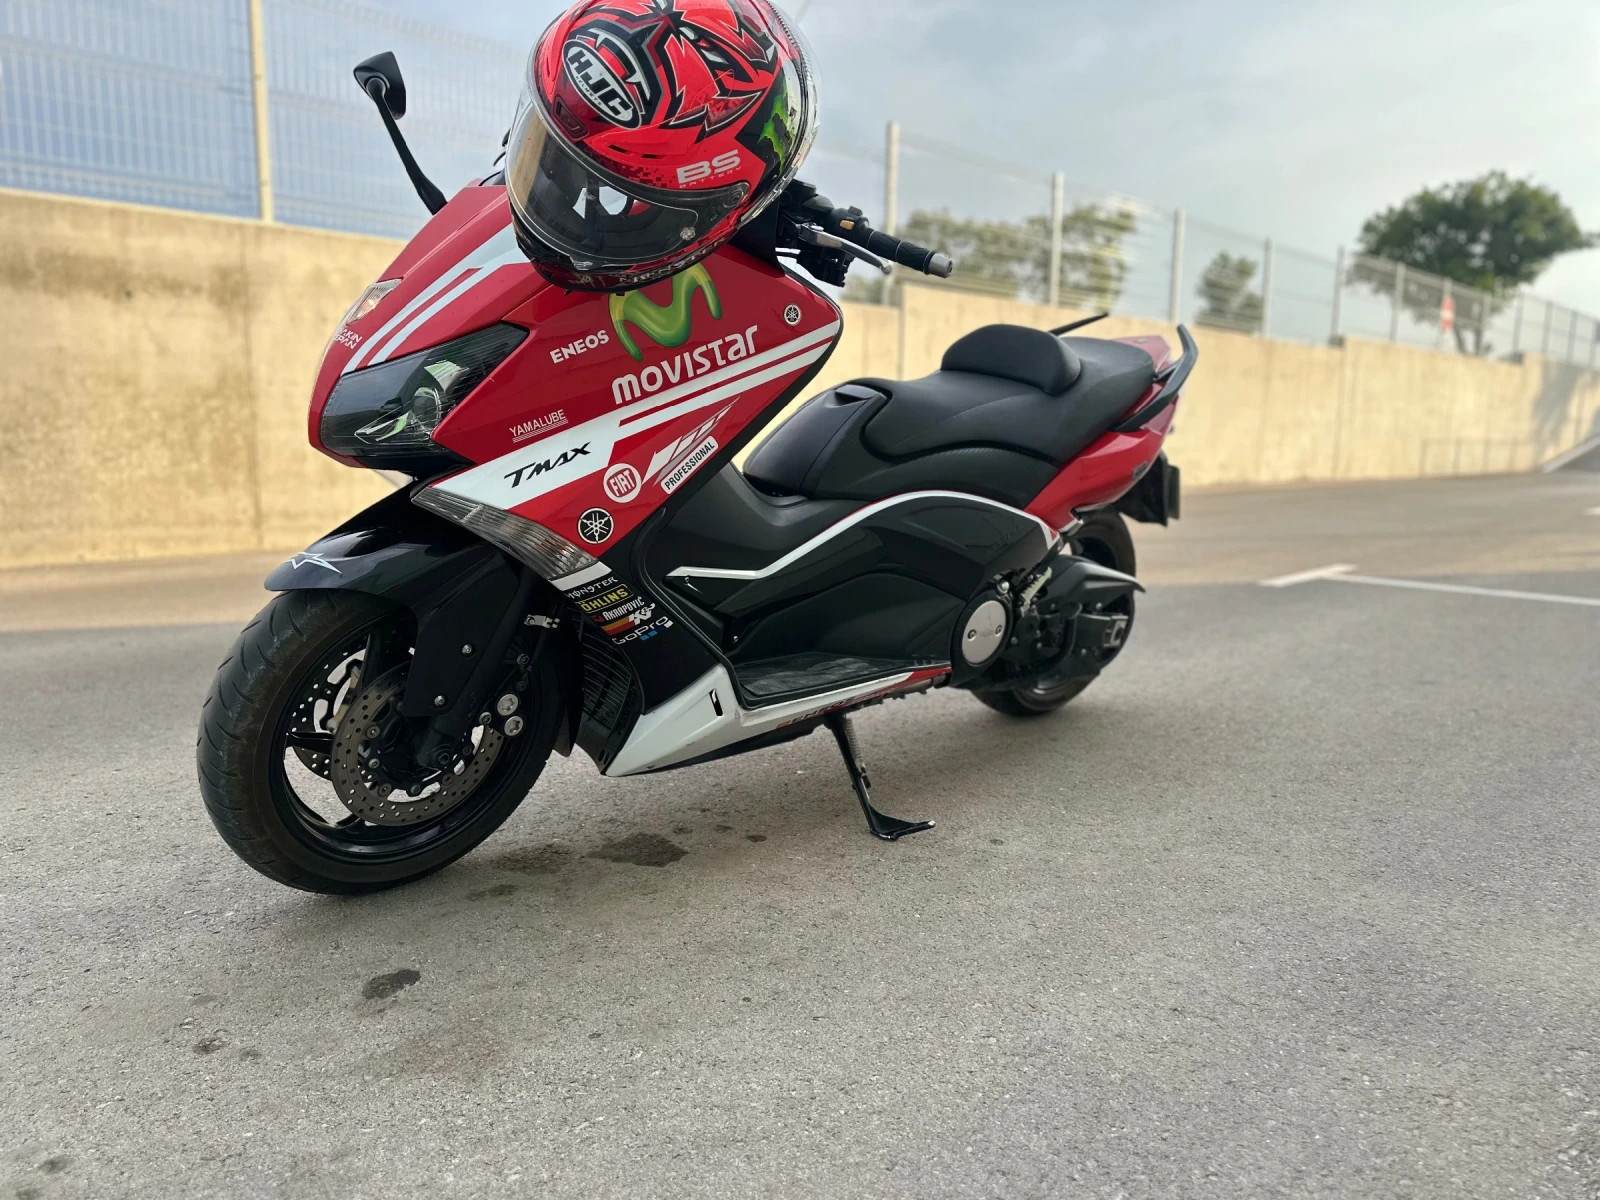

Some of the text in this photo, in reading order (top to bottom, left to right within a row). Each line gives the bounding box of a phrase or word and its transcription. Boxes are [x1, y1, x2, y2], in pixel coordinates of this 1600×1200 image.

[567, 49, 634, 116] HJC
[676, 149, 740, 184] BS
[550, 330, 609, 364] ENEOS
[611, 325, 758, 405] movistar
[509, 409, 567, 437] YAMALUBE
[504, 441, 591, 488] TMAX
[664, 441, 715, 490] PROFESSIONAL
[609, 469, 635, 498] FIAT
[580, 588, 629, 613] ÖHLINS
[612, 616, 668, 645] GoPro
